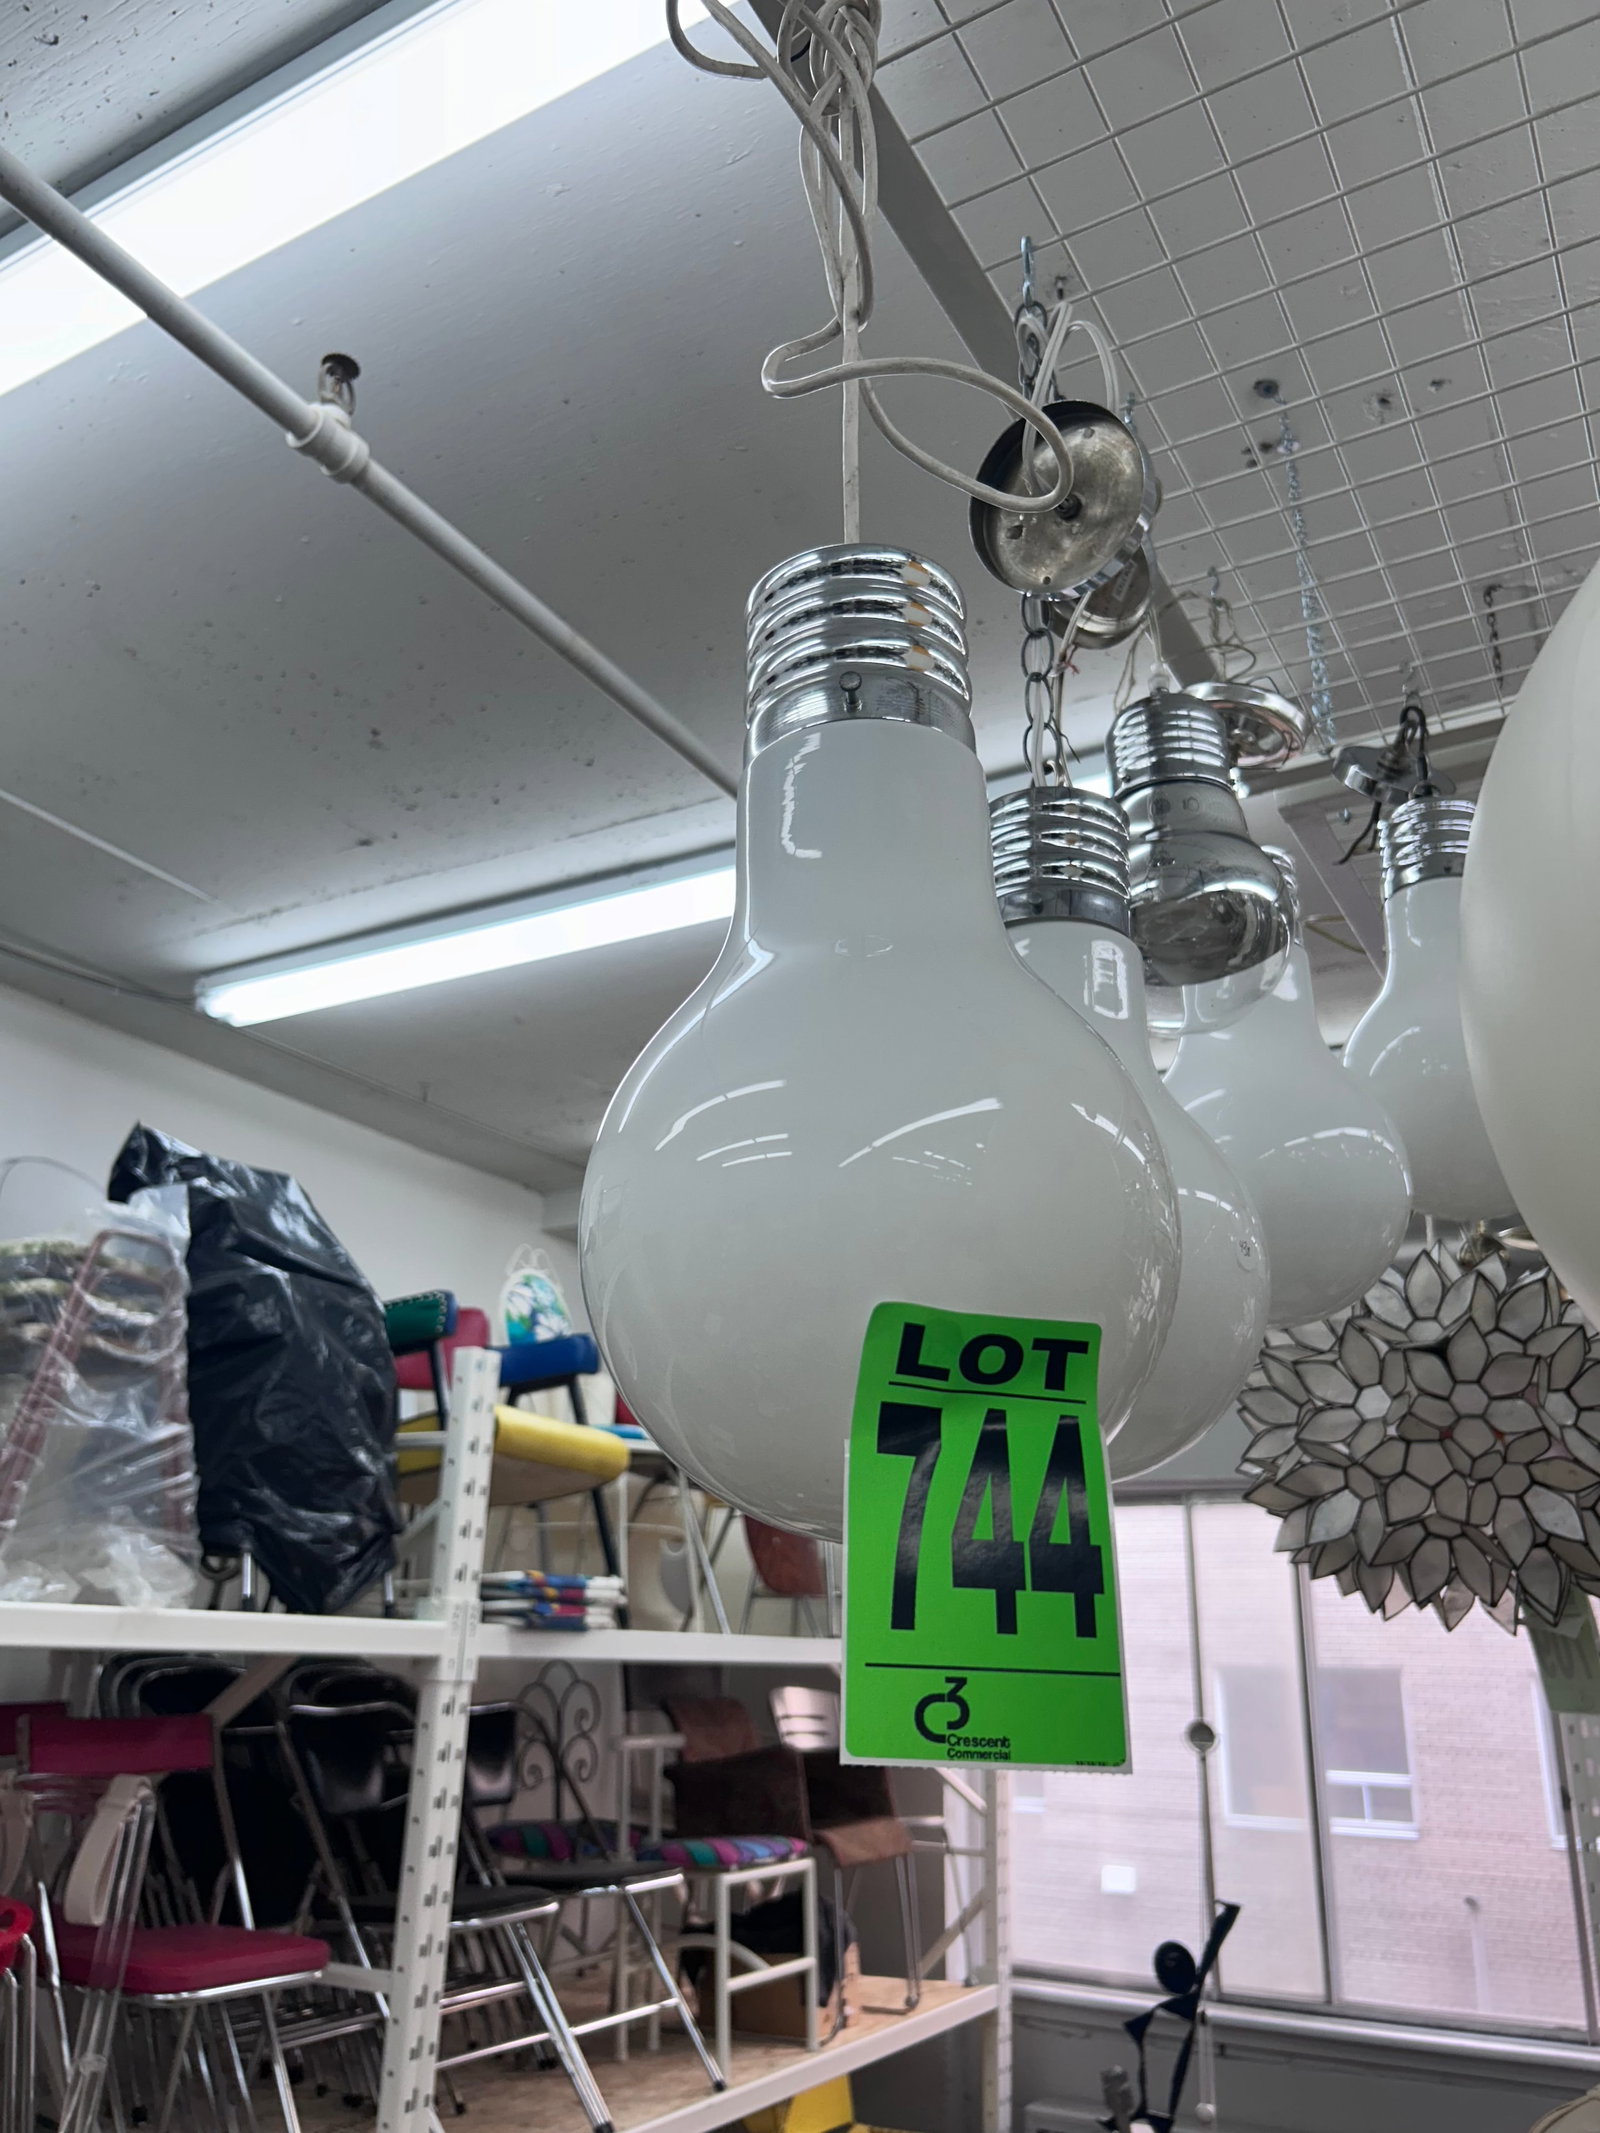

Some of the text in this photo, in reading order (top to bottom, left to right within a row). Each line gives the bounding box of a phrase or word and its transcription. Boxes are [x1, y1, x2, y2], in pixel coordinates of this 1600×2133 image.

[895, 1322, 1089, 1391] LOT
[877, 1400, 1104, 1638] 744
[947, 1733, 1011, 1748] Crescent
[947, 1748, 1011, 1760] Commercial
